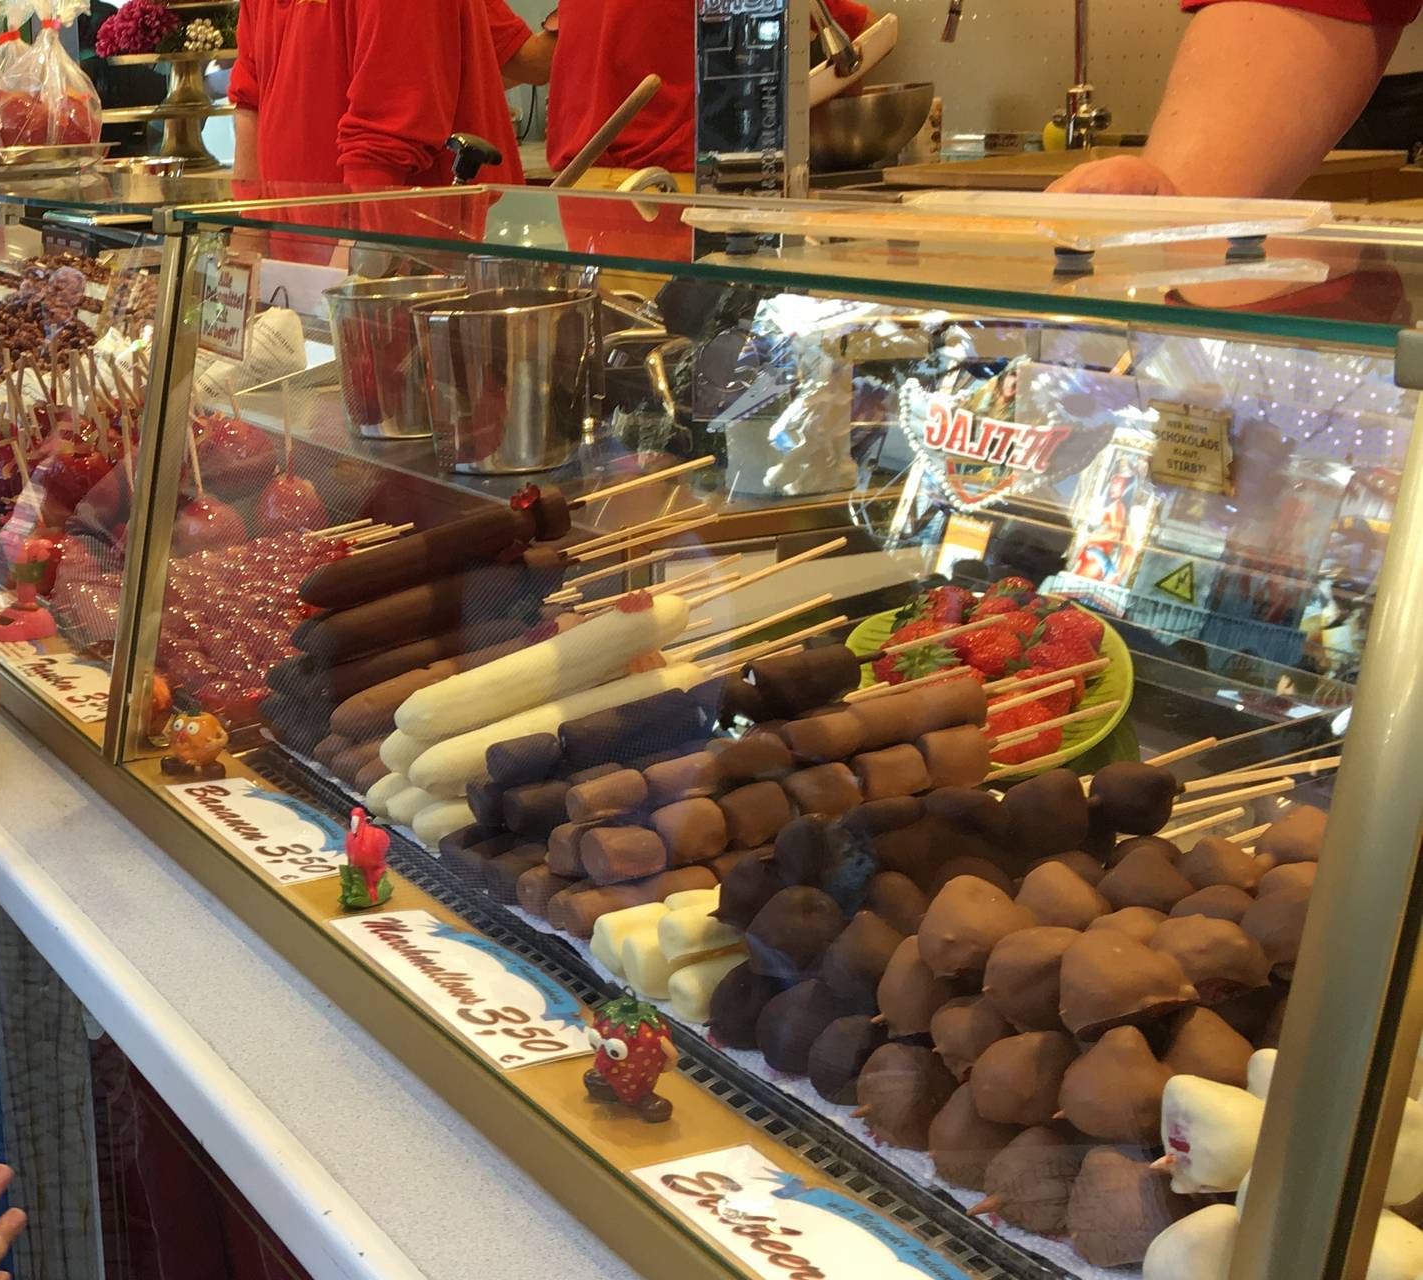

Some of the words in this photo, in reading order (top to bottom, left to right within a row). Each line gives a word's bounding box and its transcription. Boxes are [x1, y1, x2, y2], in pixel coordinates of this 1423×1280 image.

[1155, 430, 1220, 452] SCHOKOLADE
[184, 785, 269, 842] Bananen
[255, 843, 338, 873] 3,50
[361, 917, 486, 1006] Marshmallows
[456, 1006, 569, 1053] 3,50
